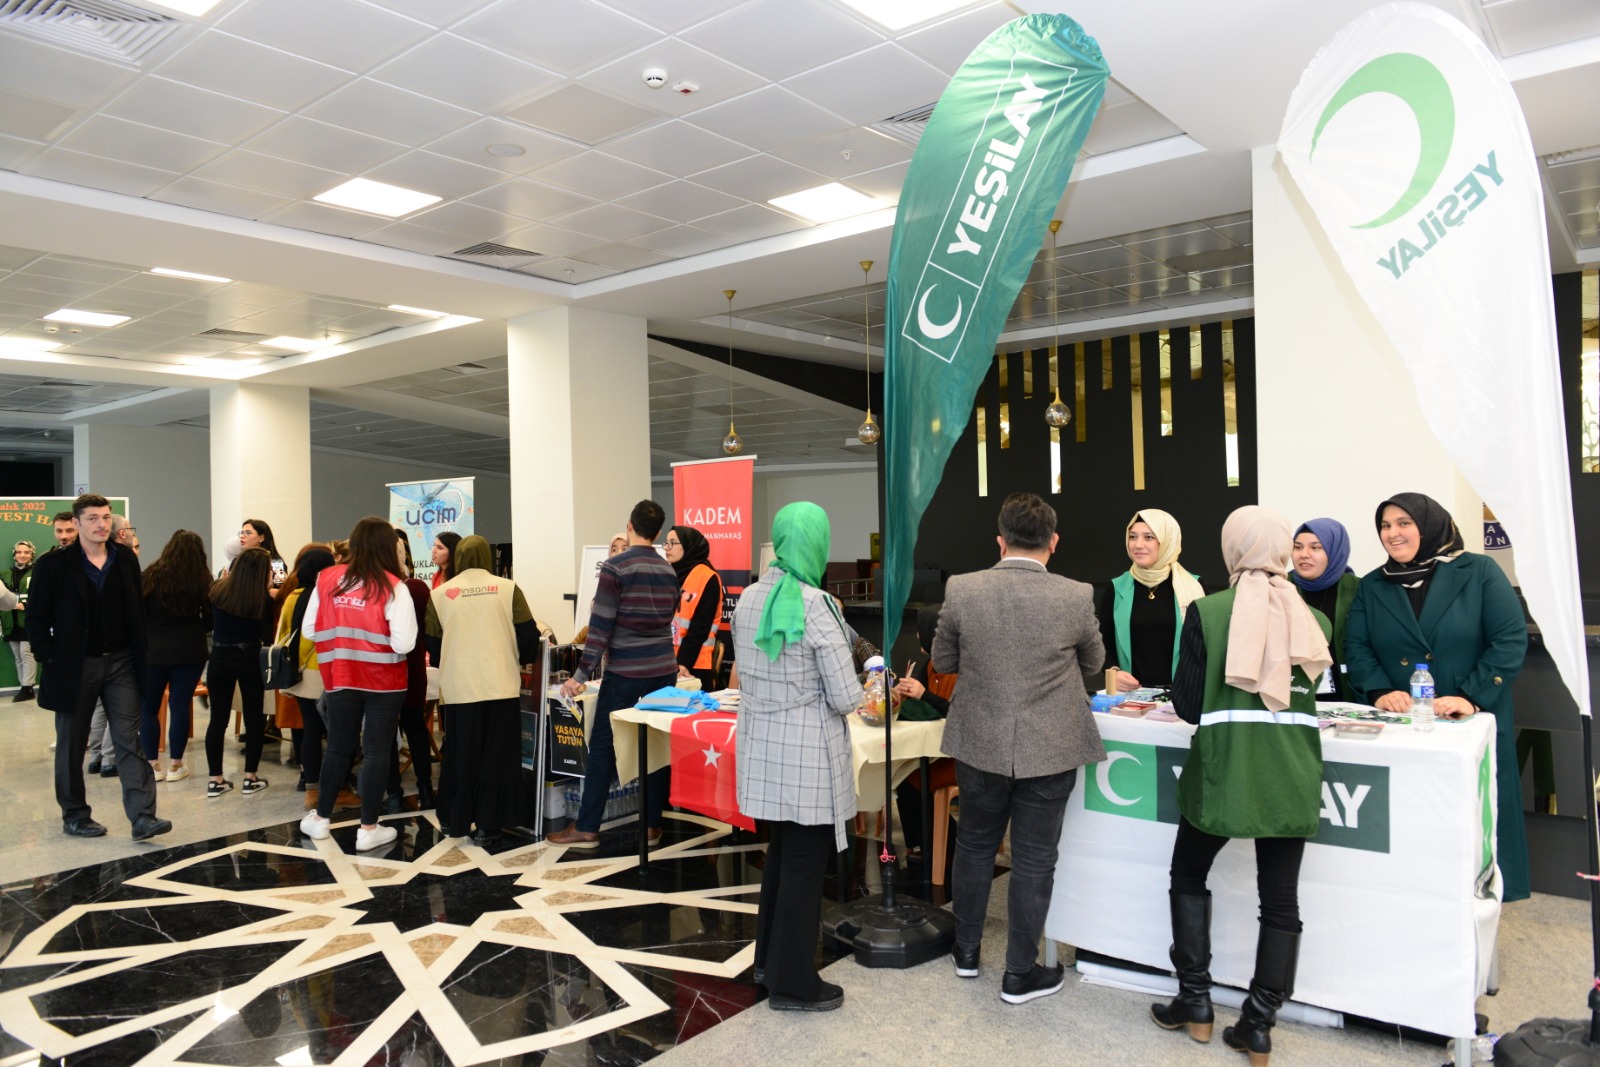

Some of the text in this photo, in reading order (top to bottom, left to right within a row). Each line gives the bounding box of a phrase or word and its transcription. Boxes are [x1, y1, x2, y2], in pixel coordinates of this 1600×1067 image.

[22, 502, 46, 510] 2022
[683, 506, 742, 526] KADEM
[703, 532, 742, 542] MANMARAŞ
